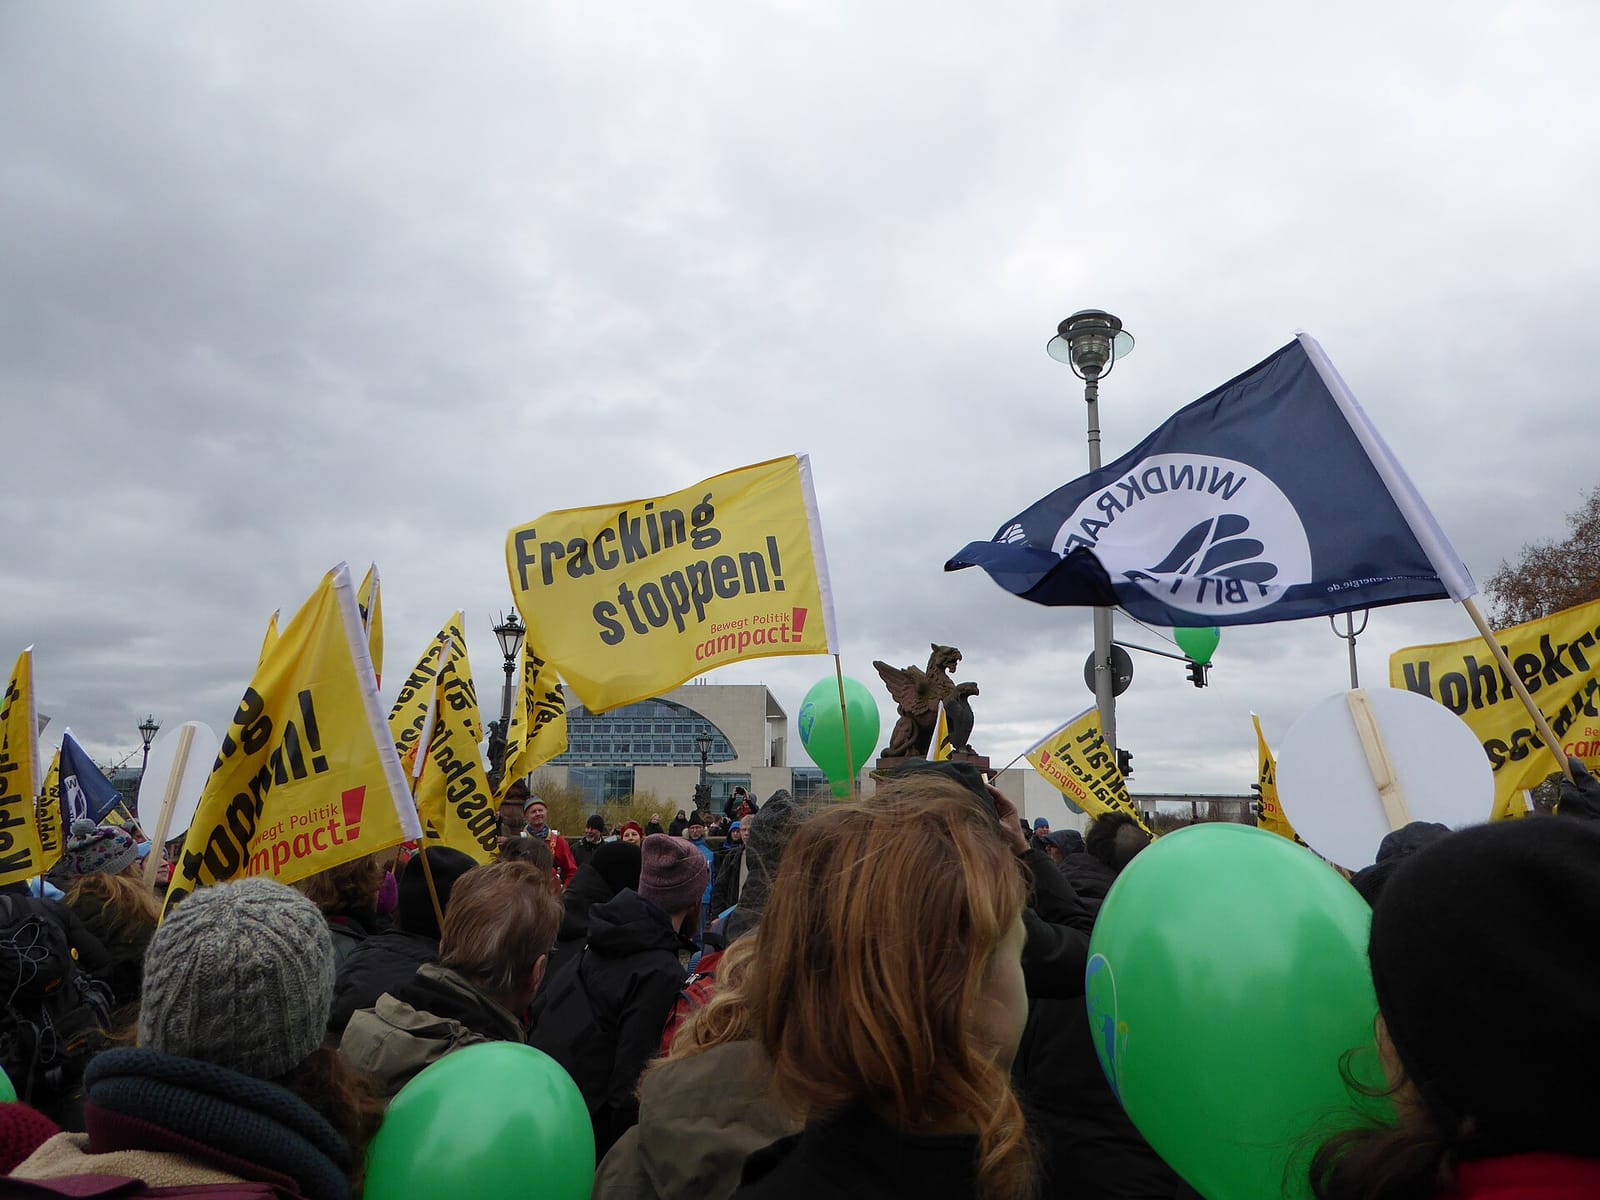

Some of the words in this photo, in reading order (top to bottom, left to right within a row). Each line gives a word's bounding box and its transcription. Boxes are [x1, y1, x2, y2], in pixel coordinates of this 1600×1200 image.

[514, 493, 722, 592] Fracking
[592, 536, 786, 646] stoppen!
[695, 607, 808, 661] campact!
[710, 618, 749, 634] Bewegt
[752, 612, 790, 625] Politik
[1402, 625, 1600, 717] Kohlekr
[248, 785, 366, 877] mpact!
[290, 803, 339, 830] Politik
